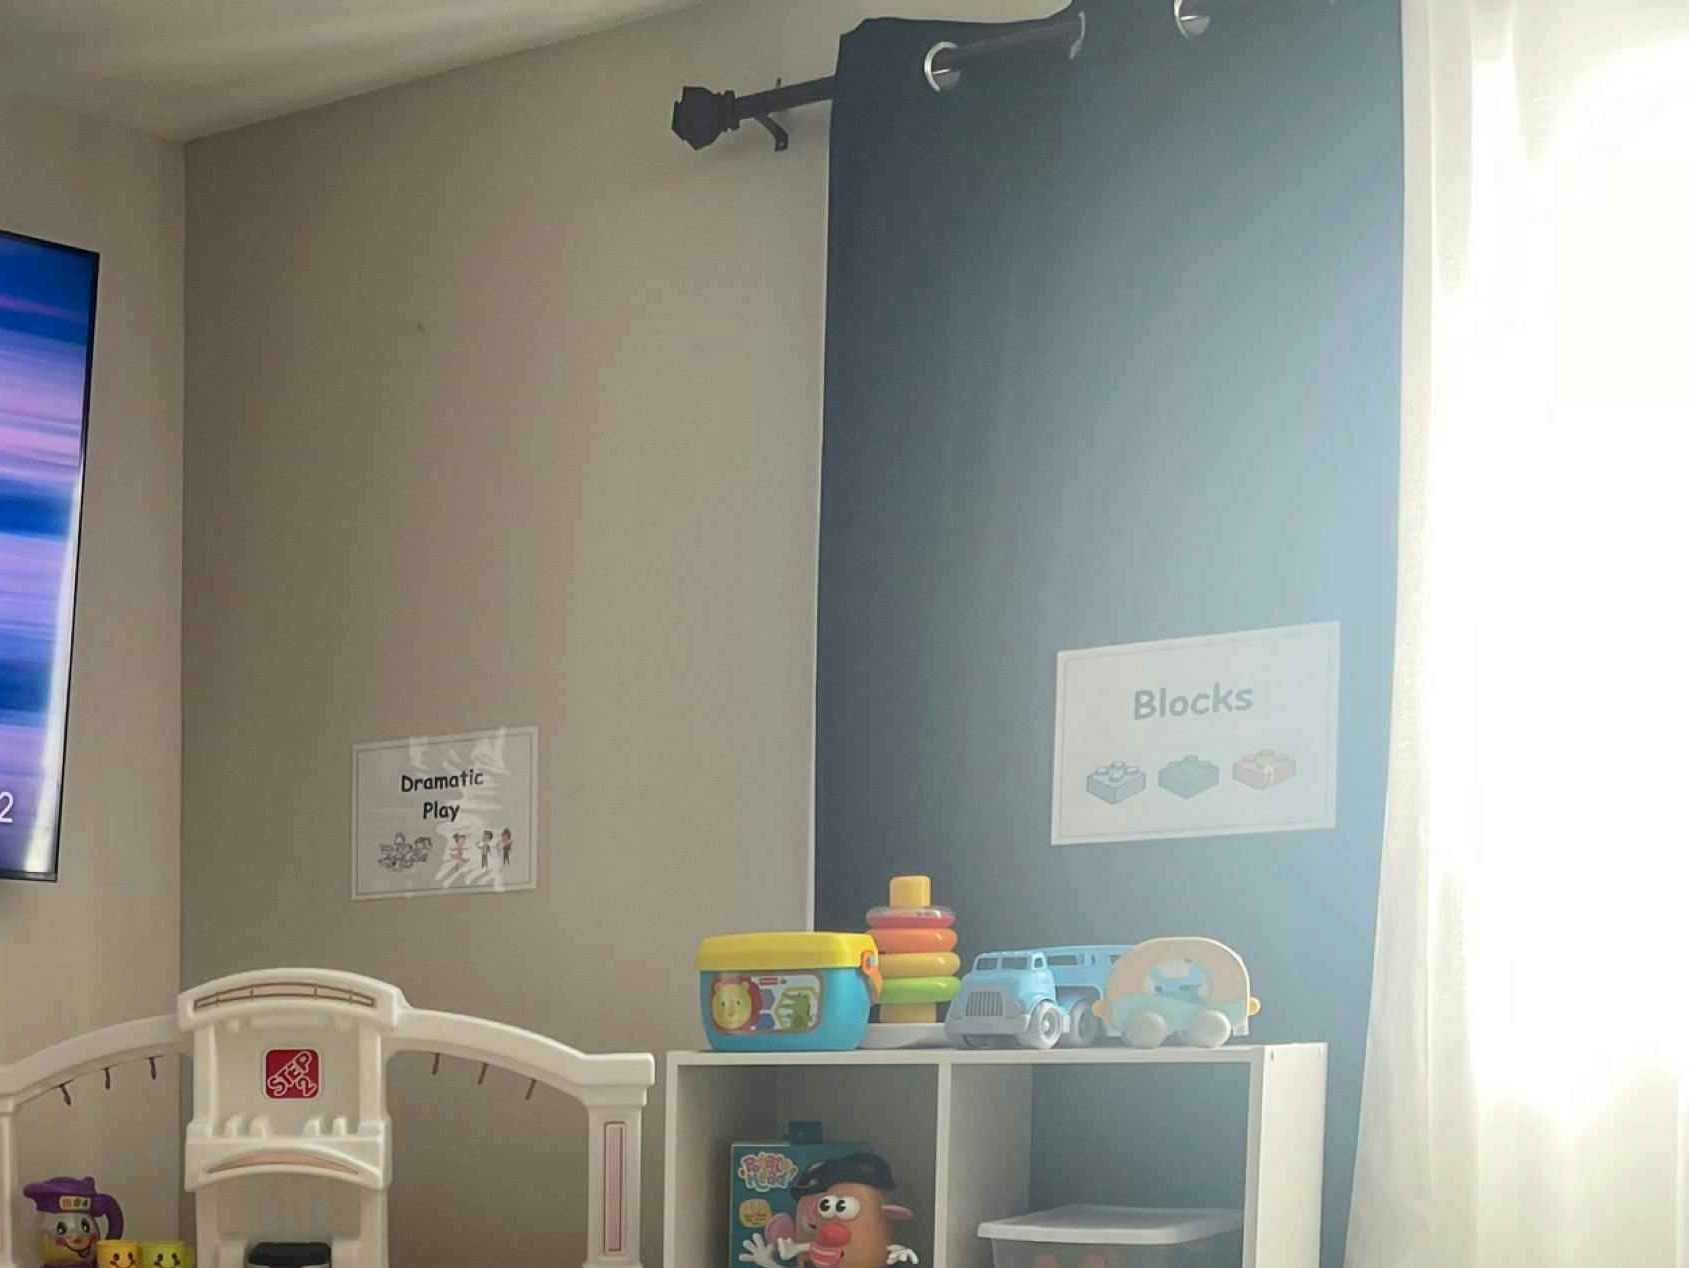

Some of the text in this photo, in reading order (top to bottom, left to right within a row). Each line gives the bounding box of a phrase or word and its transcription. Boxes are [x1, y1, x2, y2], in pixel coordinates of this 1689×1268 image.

[1133, 682, 1254, 721] Blocks
[400, 768, 485, 793] Dramatic
[422, 800, 461, 823] Play
[267, 1050, 313, 1097] STEP
[295, 1075, 317, 1097] 2
